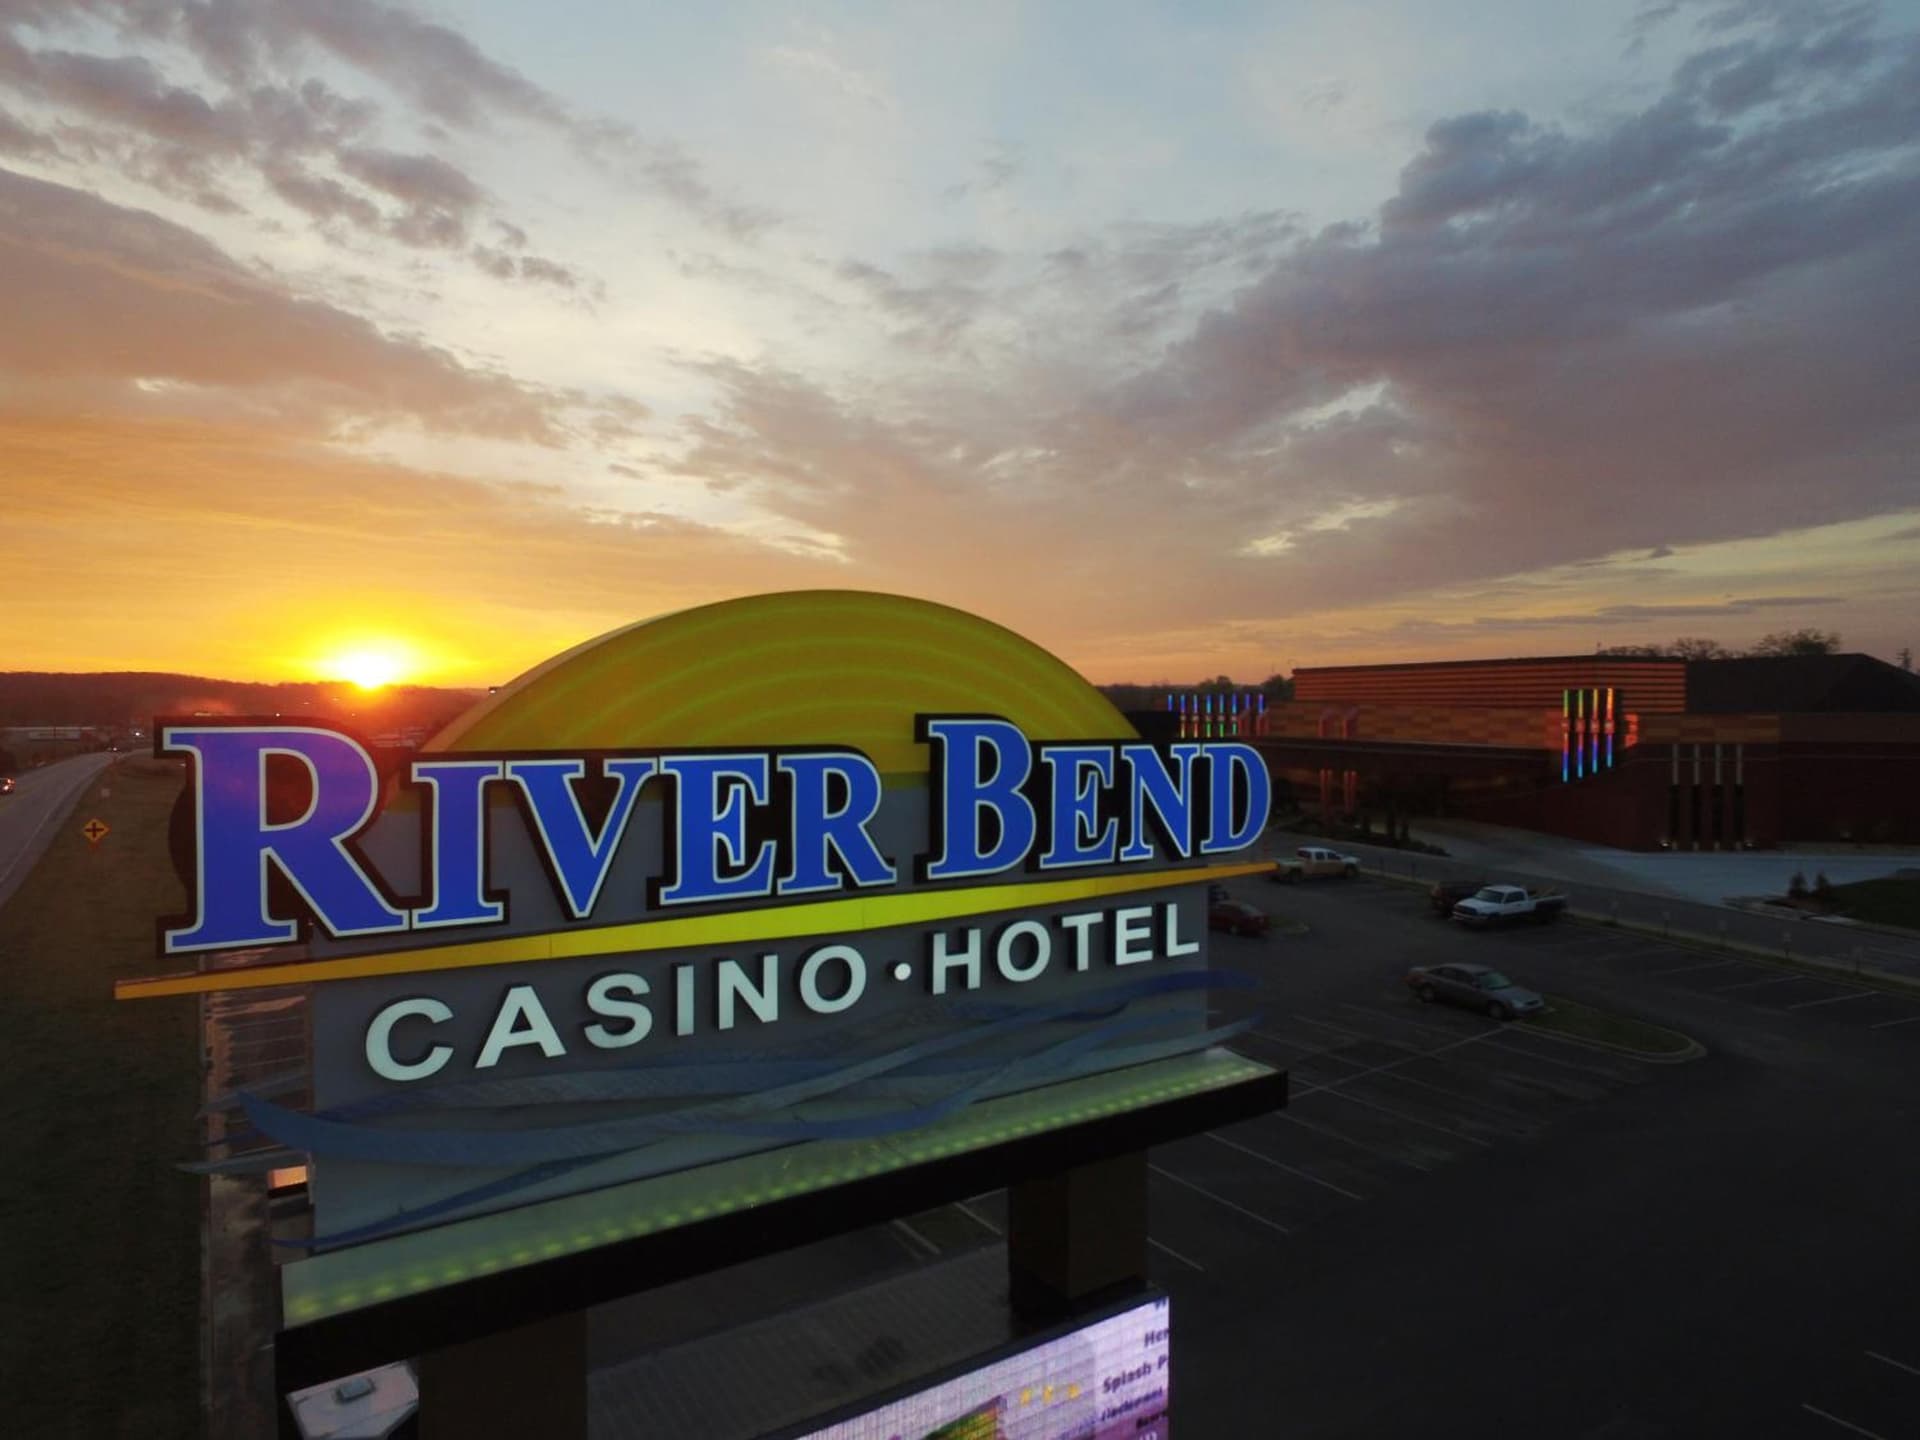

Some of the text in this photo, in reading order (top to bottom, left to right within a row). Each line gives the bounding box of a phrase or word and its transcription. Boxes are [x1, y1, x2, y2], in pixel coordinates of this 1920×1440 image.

[162, 720, 1272, 953] RIVER BEND
[365, 903, 1200, 1081] CASINO HOTEL
